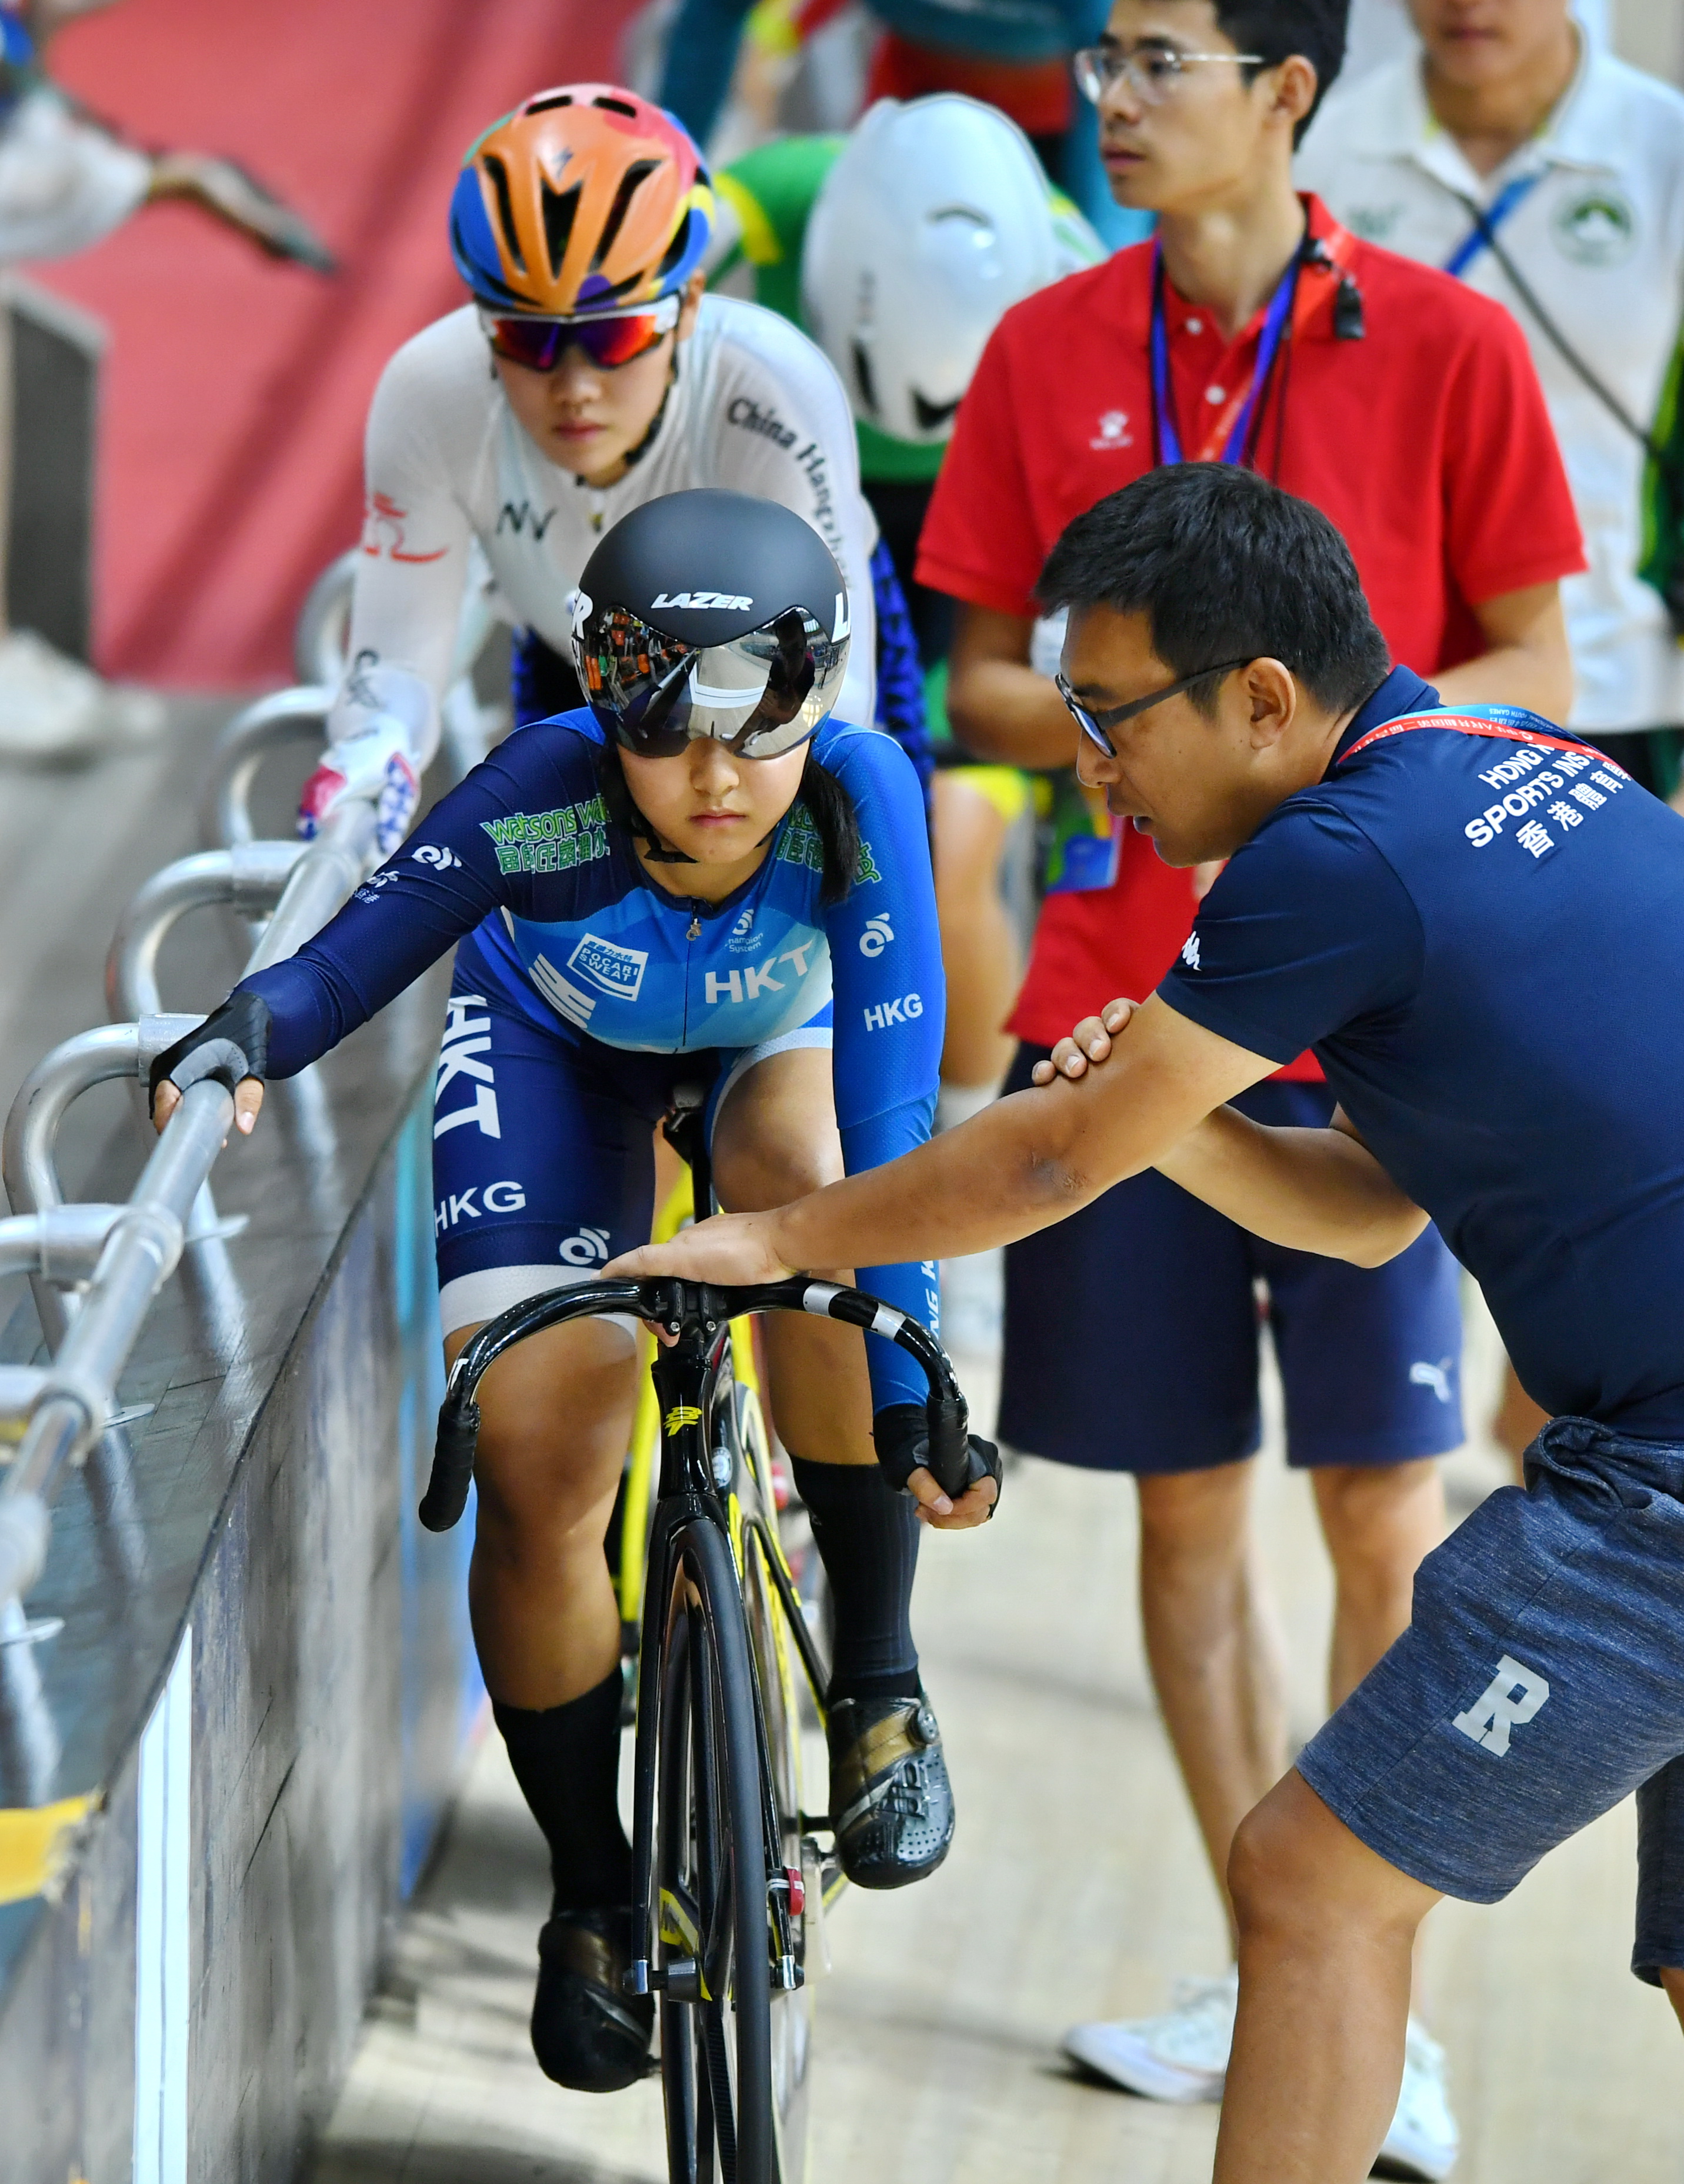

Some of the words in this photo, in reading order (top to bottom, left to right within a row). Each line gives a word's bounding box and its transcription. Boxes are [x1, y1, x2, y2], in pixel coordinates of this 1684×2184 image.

[727, 398, 798, 450] China
[651, 591, 753, 611] LAZER
[1478, 749, 1544, 790] HONG
[1465, 771, 1564, 848] SPORTS
[724, 932, 763, 947] hampion
[729, 941, 762, 953] System
[578, 953, 632, 982] SWEAT
[582, 947, 639, 976] POCARI
[705, 940, 813, 1004] HKT
[863, 993, 923, 1032] HKG
[434, 995, 501, 1139] HKT
[434, 1181, 526, 1238] HKG
[1452, 1654, 1550, 1758] R
